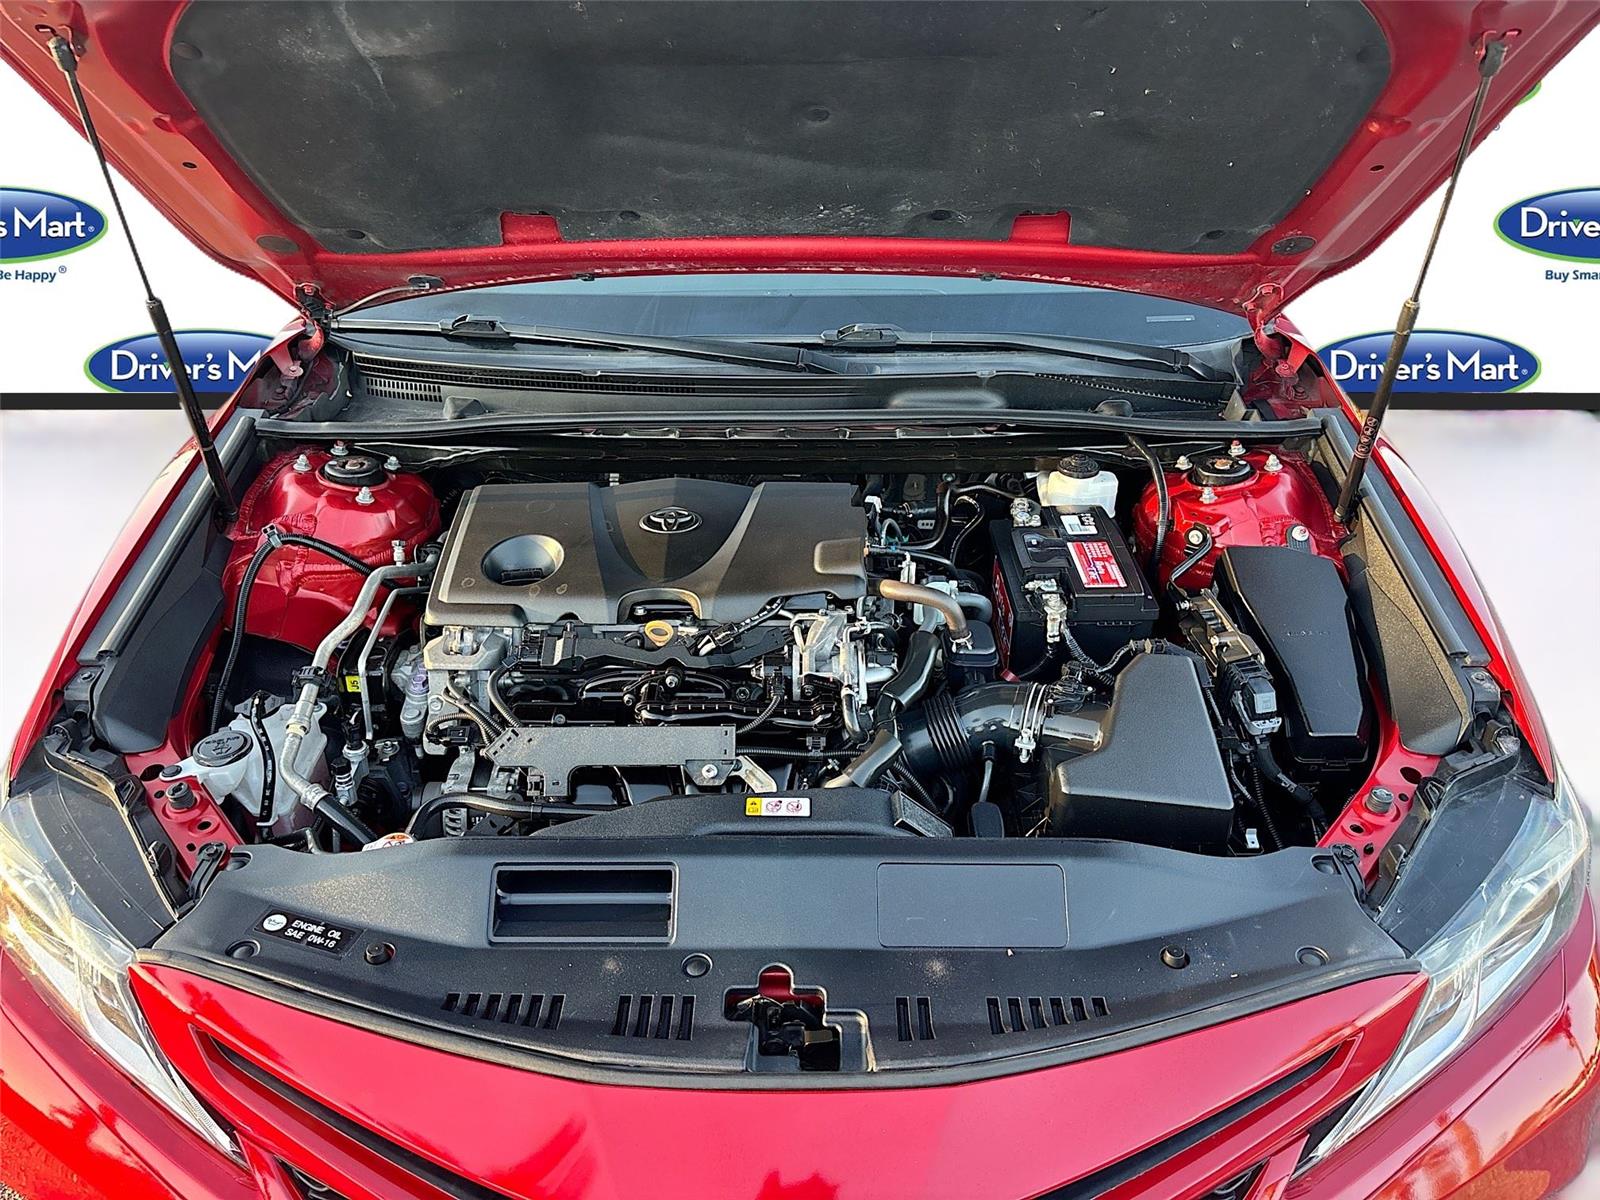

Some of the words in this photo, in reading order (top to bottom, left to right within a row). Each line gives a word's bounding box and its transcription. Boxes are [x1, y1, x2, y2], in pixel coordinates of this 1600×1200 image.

[14, 206, 86, 238] Mart
[1521, 206, 1600, 238] Drive
[15, 270, 57, 283] Happy
[1545, 269, 1570, 283] Buy
[1447, 349, 1519, 380] Mart
[284, 928, 306, 940] SAE
[307, 934, 337, 948] 0W-16
[292, 920, 326, 934] ENGINE
[327, 930, 342, 940] OIL
